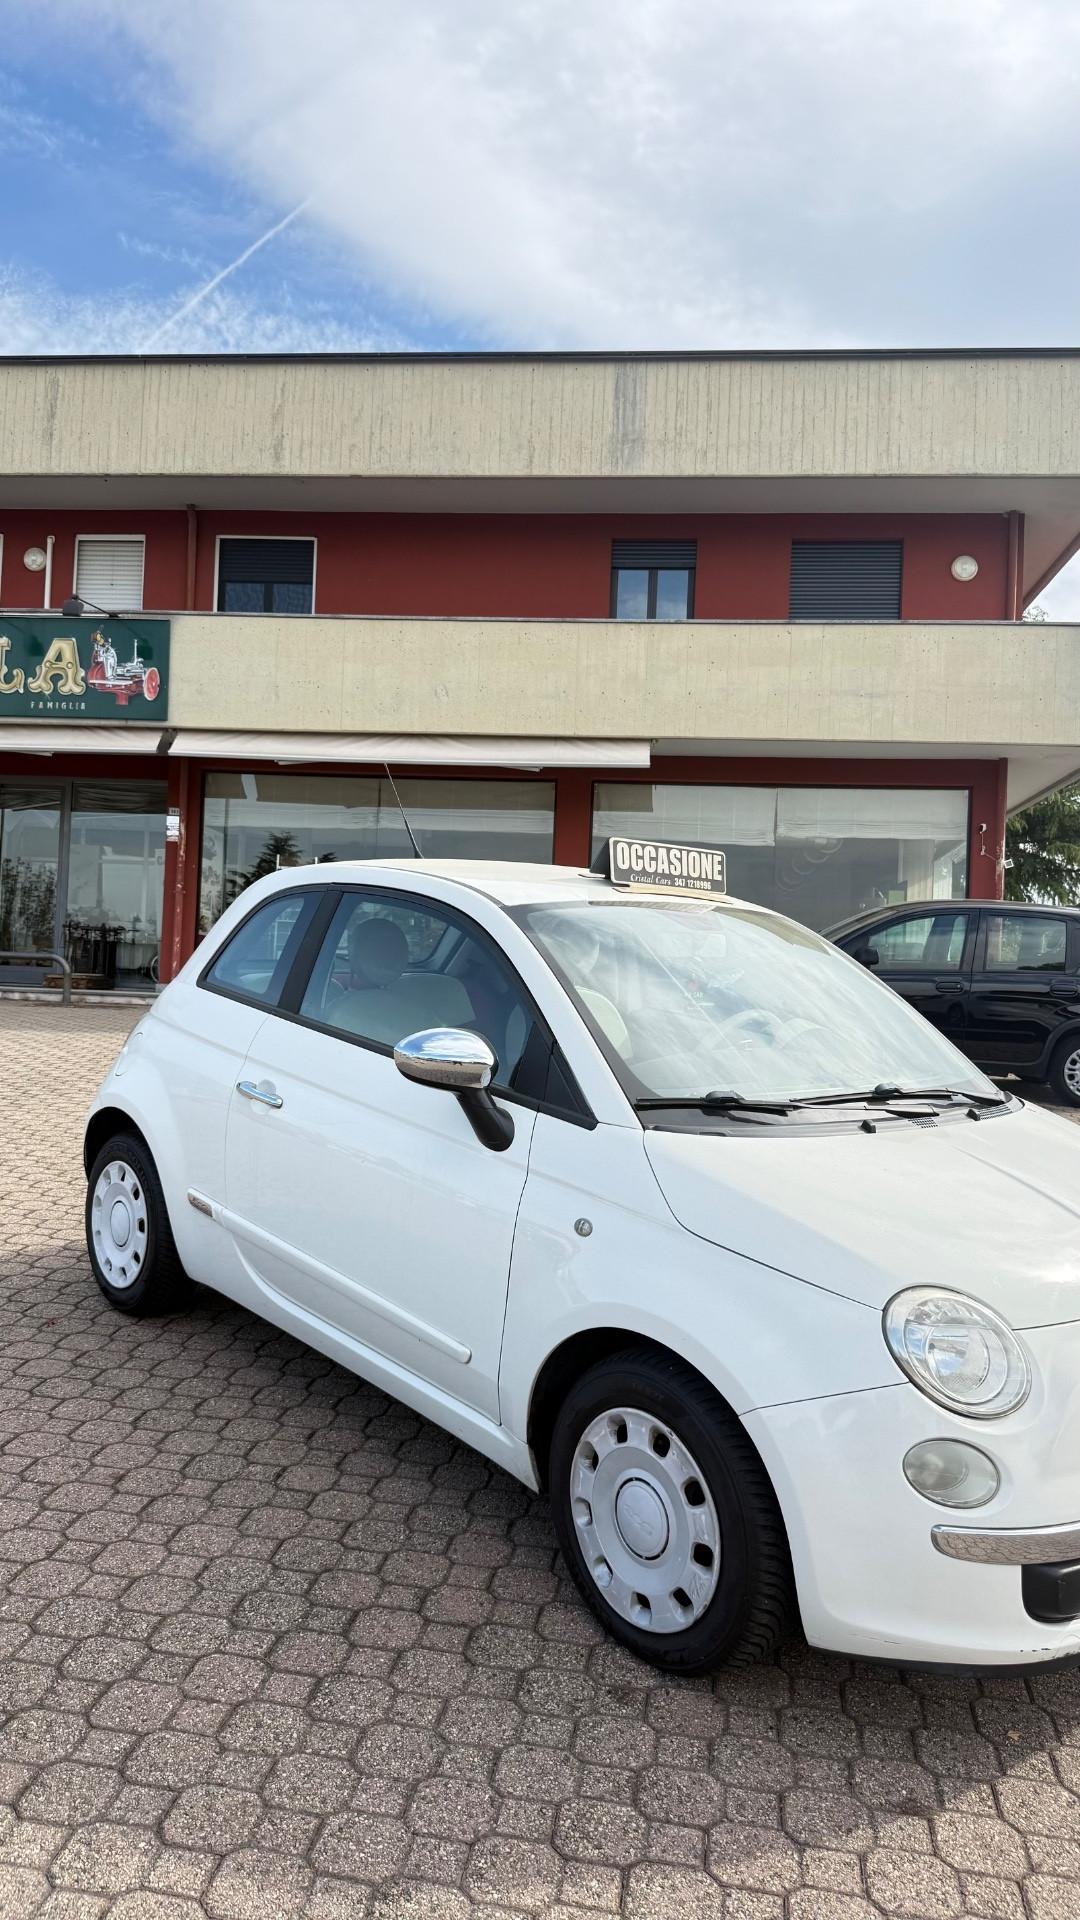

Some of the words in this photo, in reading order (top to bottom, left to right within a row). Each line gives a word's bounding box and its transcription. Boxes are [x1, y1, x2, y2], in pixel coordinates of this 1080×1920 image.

[30, 702, 86, 710] FAMIGLIA
[616, 842, 723, 880] OCCASIONE
[630, 873, 654, 884] Cristal
[655, 876, 671, 885] Cars
[674, 878, 686, 887] 347
